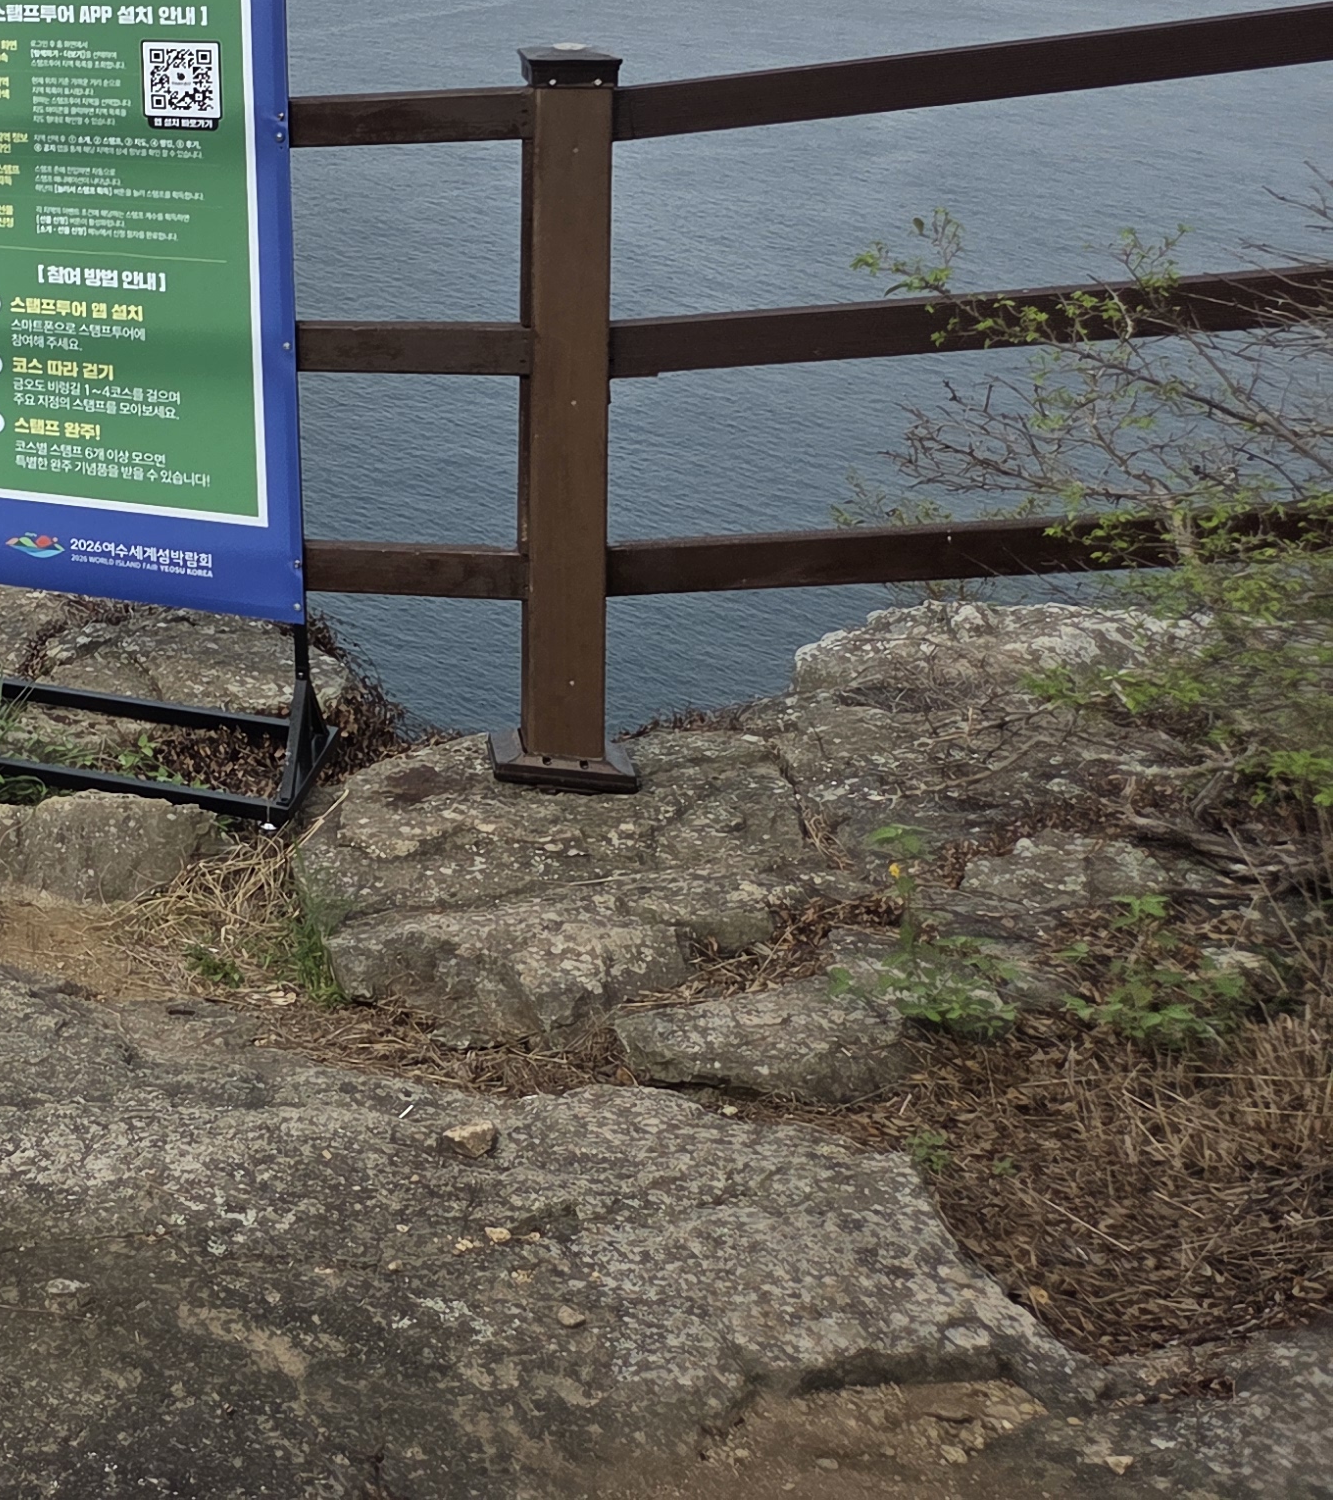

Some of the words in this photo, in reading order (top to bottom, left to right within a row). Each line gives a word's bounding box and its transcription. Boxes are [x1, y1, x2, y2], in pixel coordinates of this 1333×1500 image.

[80, 6, 112, 23] APP
[117, 6, 153, 25] 설치
[159, 6, 195, 25] 안내
[48, 266, 81, 285] 참여
[84, 269, 118, 288] 방법
[122, 271, 156, 291] 안내
[10, 297, 86, 318] 스탬프투어
[91, 303, 107, 319] 앱
[111, 304, 143, 322] 설치
[11, 319, 76, 335] 스마트폰으로
[79, 324, 146, 341] 스탬프투어에
[47, 337, 83, 351] 주세요.
[12, 357, 43, 374] 코스
[47, 359, 79, 377] 따라
[13, 378, 46, 392] 금오도
[48, 379, 81, 395] 비렁길
[13, 393, 35, 406] 주요
[72, 399, 117, 415] 스탬프를
[119, 403, 180, 420] 모아보세요.
[14, 416, 60, 436] 스탬프
[64, 422, 101, 440] 완주!
[14, 440, 48, 455] 코스별
[49, 443, 83, 458] 스탬프
[84, 446, 105, 461] 6개
[107, 449, 129, 463] 이상
[132, 451, 166, 468] 모으면
[15, 454, 48, 471] 특별한
[50, 458, 72, 473] 완주
[74, 461, 119, 479] 기념품을
[121, 465, 144, 481] 받을
[146, 468, 159, 482] 수
[161, 470, 211, 487] 있습니다!
[70, 538, 213, 568] 2026여수세계섬박람회
[89, 556, 114, 566] WORLD
[115, 560, 141, 569] ISLAND
[160, 565, 185, 575] YEOSU
[187, 569, 213, 578] KOREA
